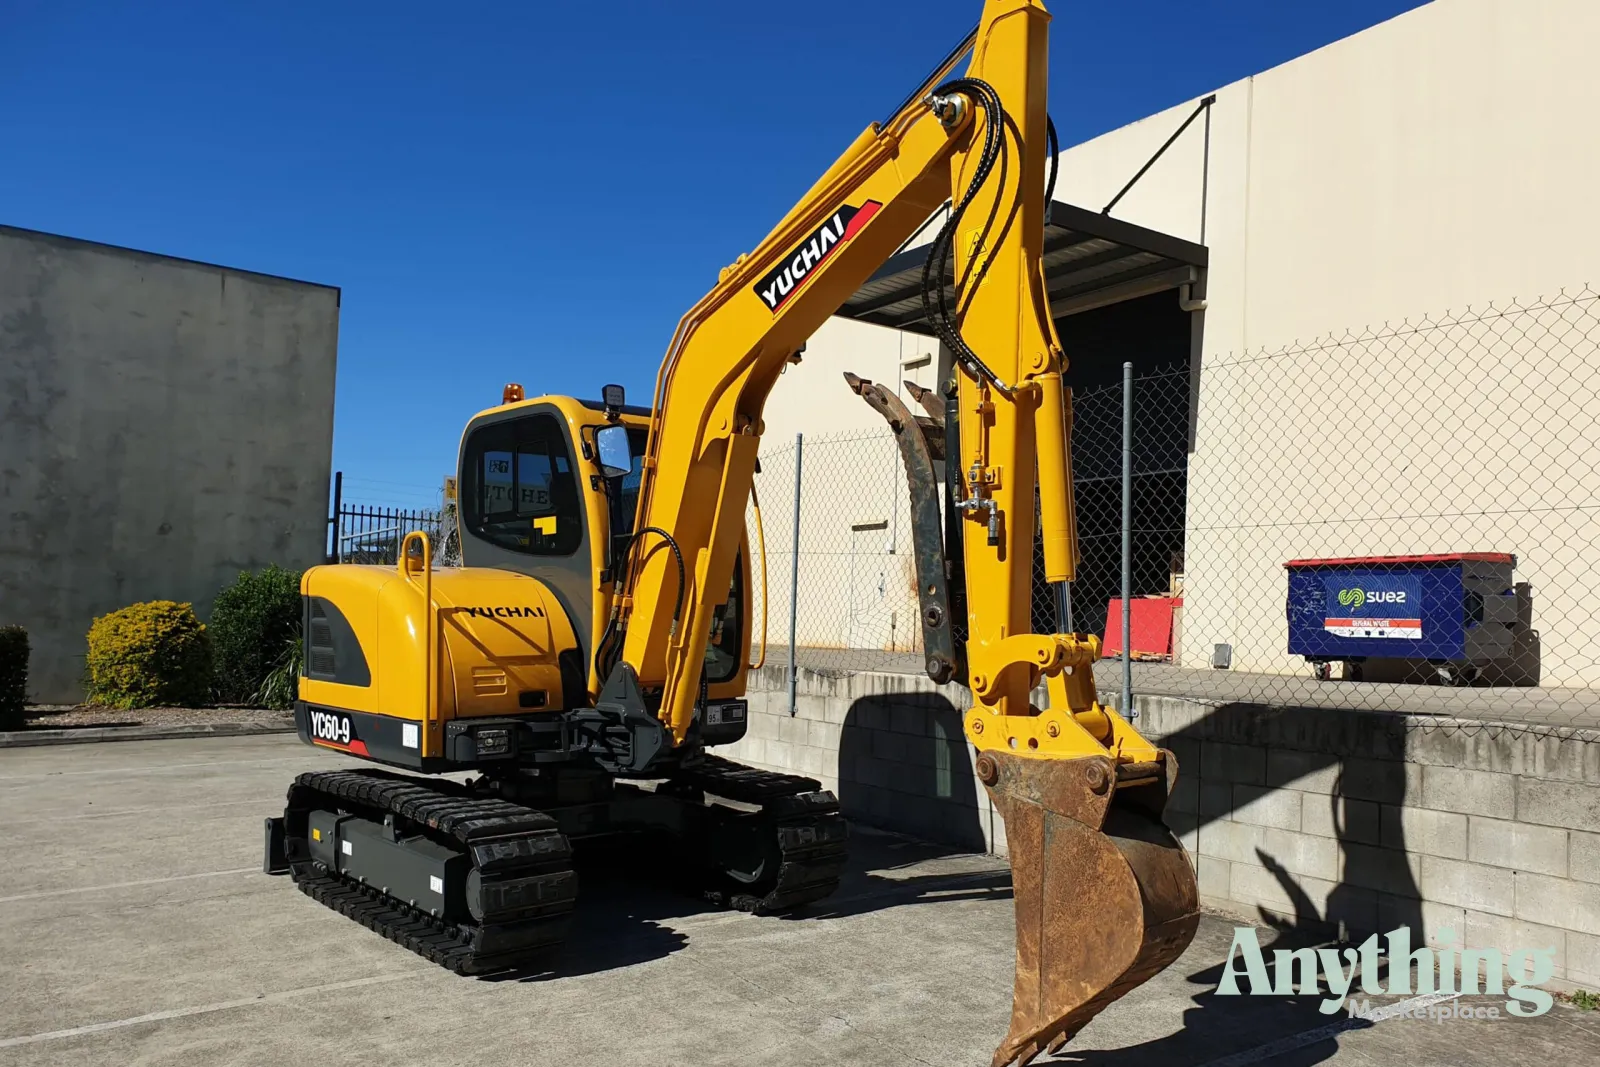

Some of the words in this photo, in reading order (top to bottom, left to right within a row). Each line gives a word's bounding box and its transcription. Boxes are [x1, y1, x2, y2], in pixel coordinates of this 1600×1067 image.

[762, 213, 845, 308] YUCHAI
[1366, 591, 1406, 603] suez
[466, 606, 545, 618] YUCHAI
[311, 711, 350, 744] YC60-9
